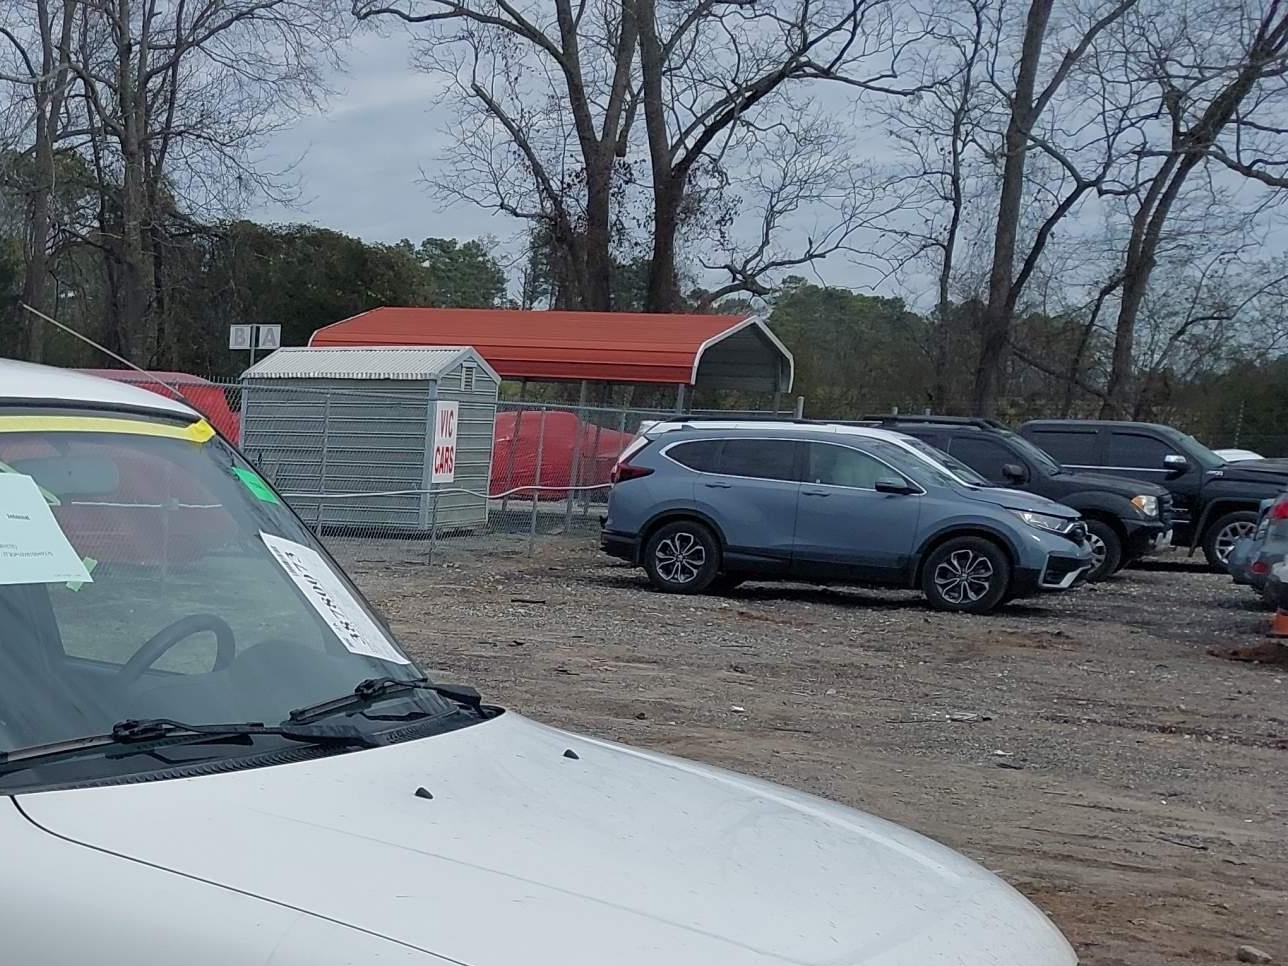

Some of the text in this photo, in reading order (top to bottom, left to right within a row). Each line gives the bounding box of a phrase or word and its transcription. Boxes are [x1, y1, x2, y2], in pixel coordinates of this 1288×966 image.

[235, 328, 245, 345] B
[262, 328, 277, 346] A
[440, 410, 454, 437] VIC
[435, 446, 454, 474] CARS
